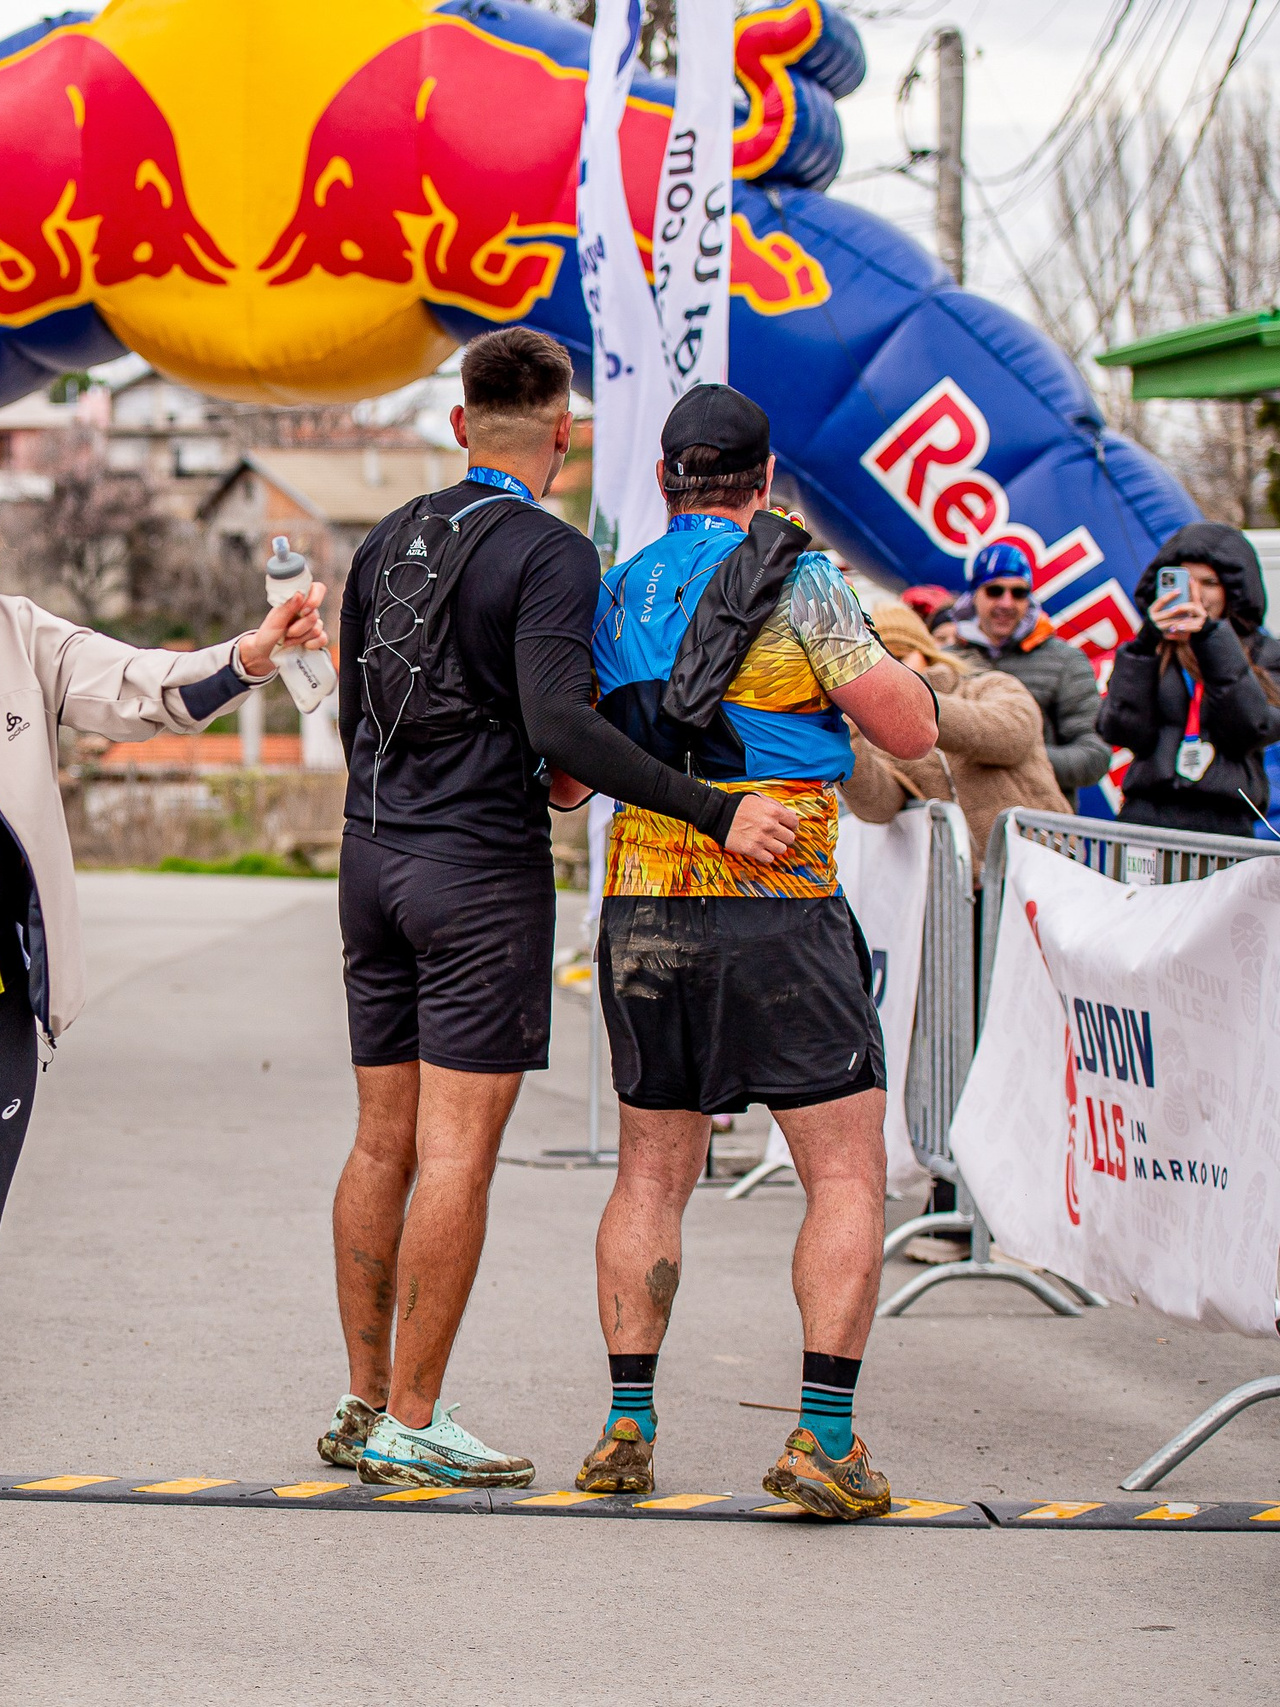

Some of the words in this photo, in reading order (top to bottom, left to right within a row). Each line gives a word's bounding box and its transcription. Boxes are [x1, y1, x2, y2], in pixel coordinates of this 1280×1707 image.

[870, 386, 1095, 597] Red
[640, 562, 666, 623] EVADICT
[749, 568, 766, 595] KIPRUN
[1131, 1119, 1148, 1144] IN
[1133, 1156, 1229, 1190] MARKOVO
